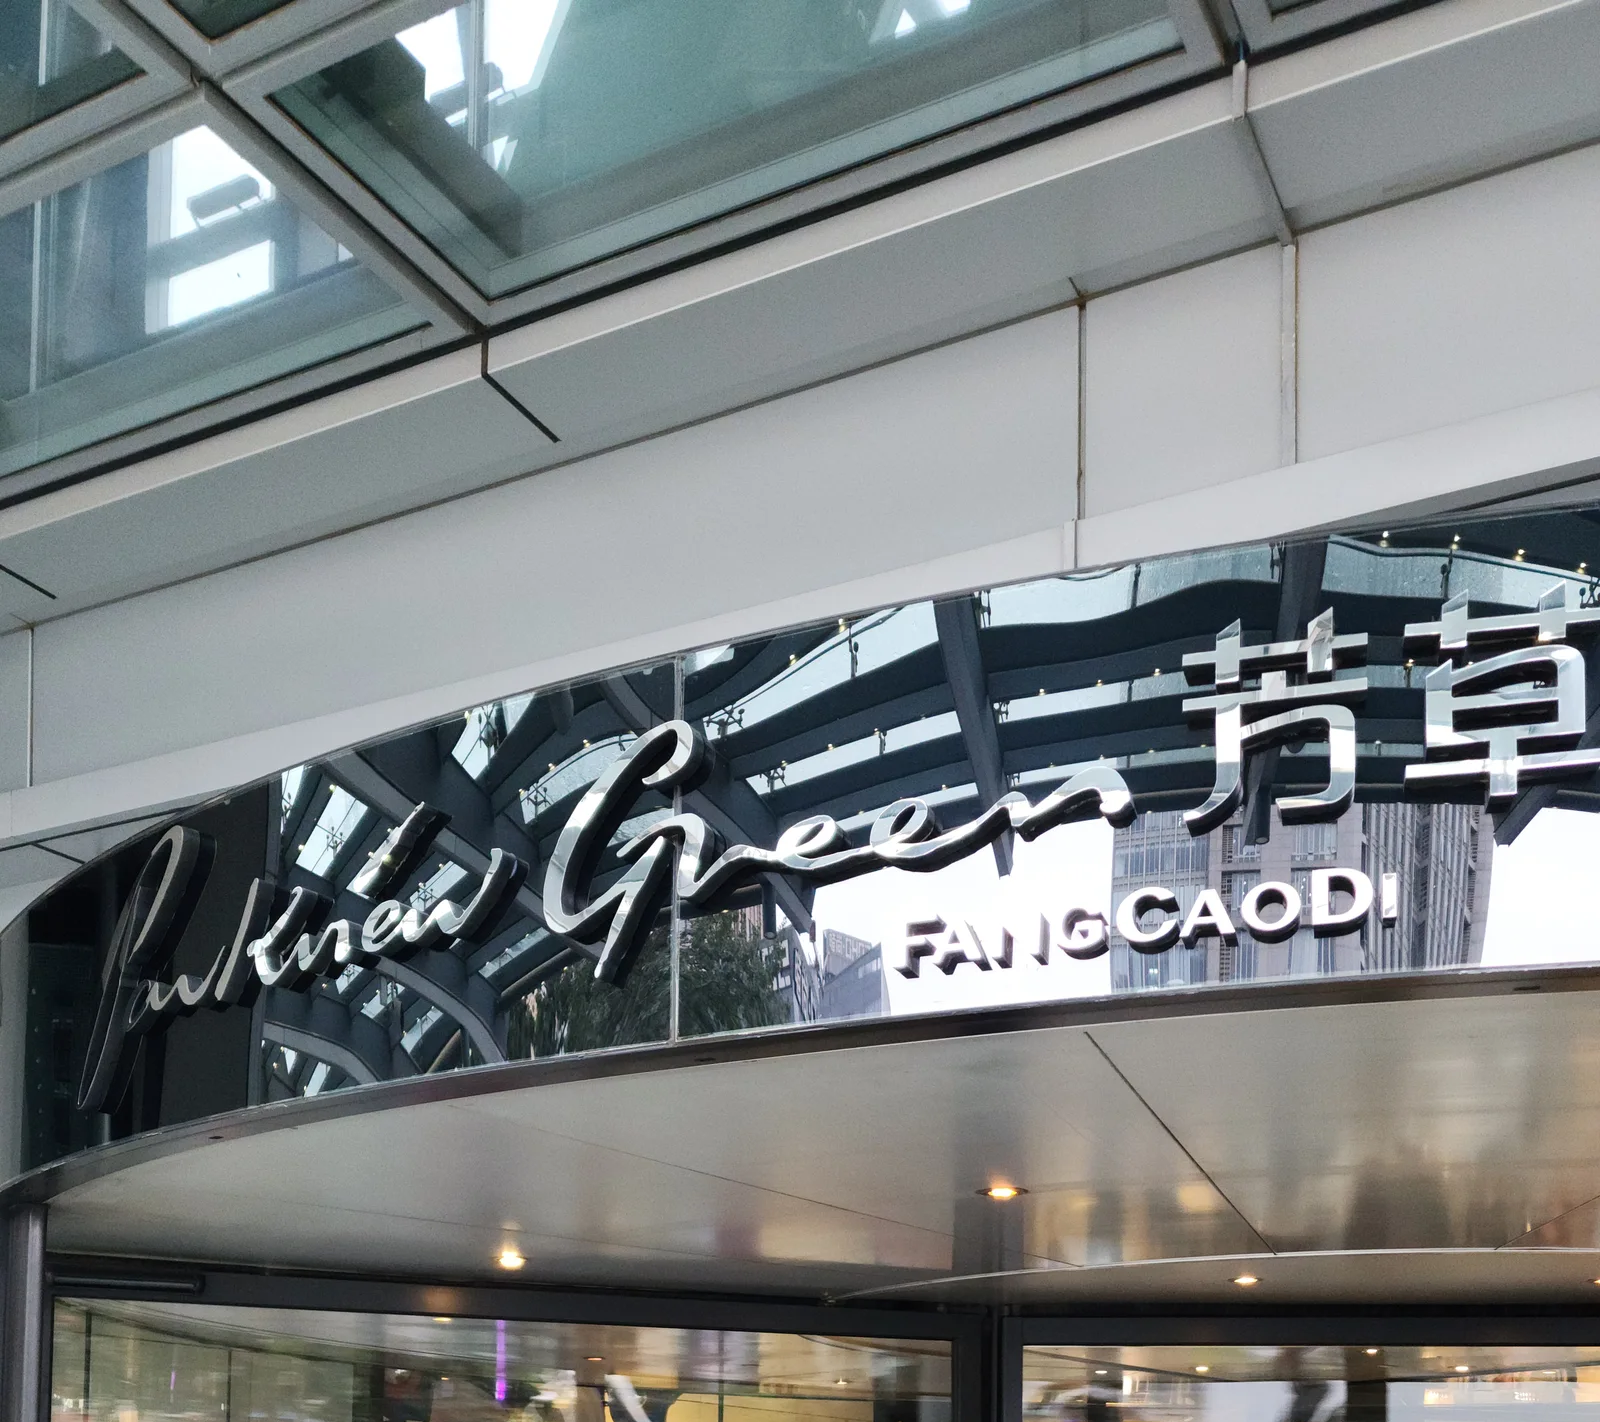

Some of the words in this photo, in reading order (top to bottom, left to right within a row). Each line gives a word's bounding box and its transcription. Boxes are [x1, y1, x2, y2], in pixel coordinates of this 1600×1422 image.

[543, 720, 1136, 985] Green
[1182, 580, 1600, 837] 芳草
[893, 868, 1399, 979] FANGCAODI
